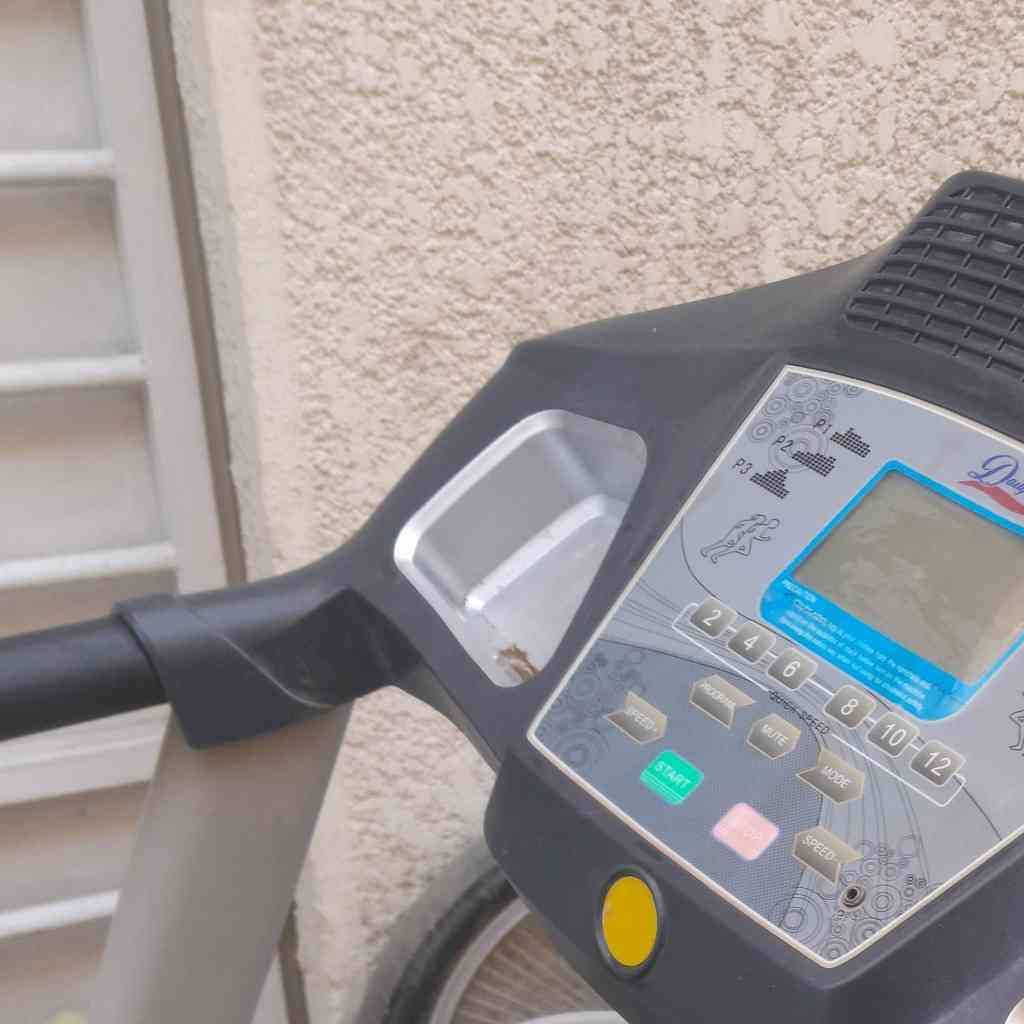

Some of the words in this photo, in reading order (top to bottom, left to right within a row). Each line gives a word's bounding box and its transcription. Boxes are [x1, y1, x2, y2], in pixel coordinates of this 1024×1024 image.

[813, 418, 832, 435] P1
[773, 435, 794, 452] P2
[732, 457, 752, 475] P3
[702, 608, 721, 627] 2
[742, 634, 760, 651] 4
[782, 659, 800, 678] 6
[839, 698, 858, 716] 8
[879, 723, 906, 746] 10
[923, 750, 951, 776] 12
[760, 723, 789, 747] MUTE
[799, 711, 831, 737] SPEED
[653, 759, 691, 789] START
[821, 764, 851, 790] MODE
